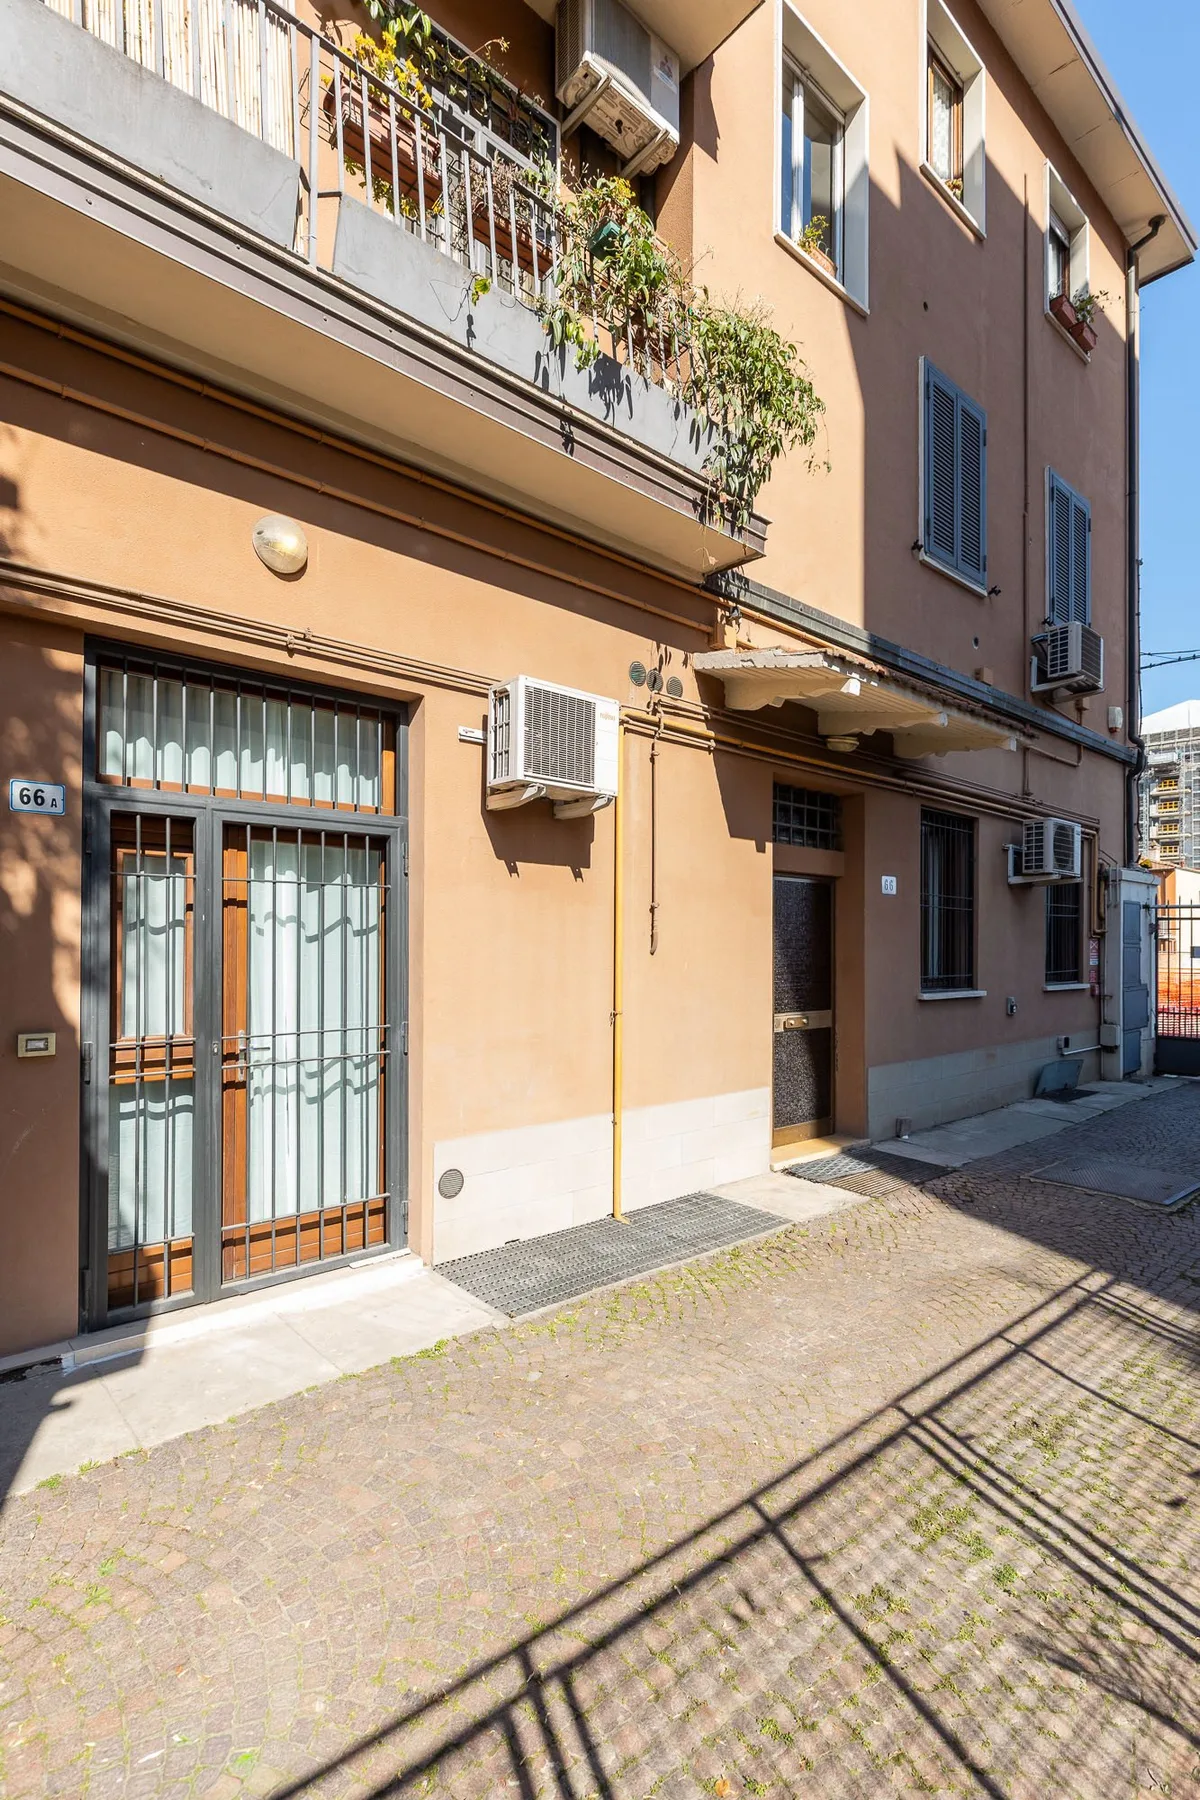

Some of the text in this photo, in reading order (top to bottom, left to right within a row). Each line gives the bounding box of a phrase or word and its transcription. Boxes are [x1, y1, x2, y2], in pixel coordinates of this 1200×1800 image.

[19, 787, 58, 808] 66 A
[884, 879, 894, 891] 66
